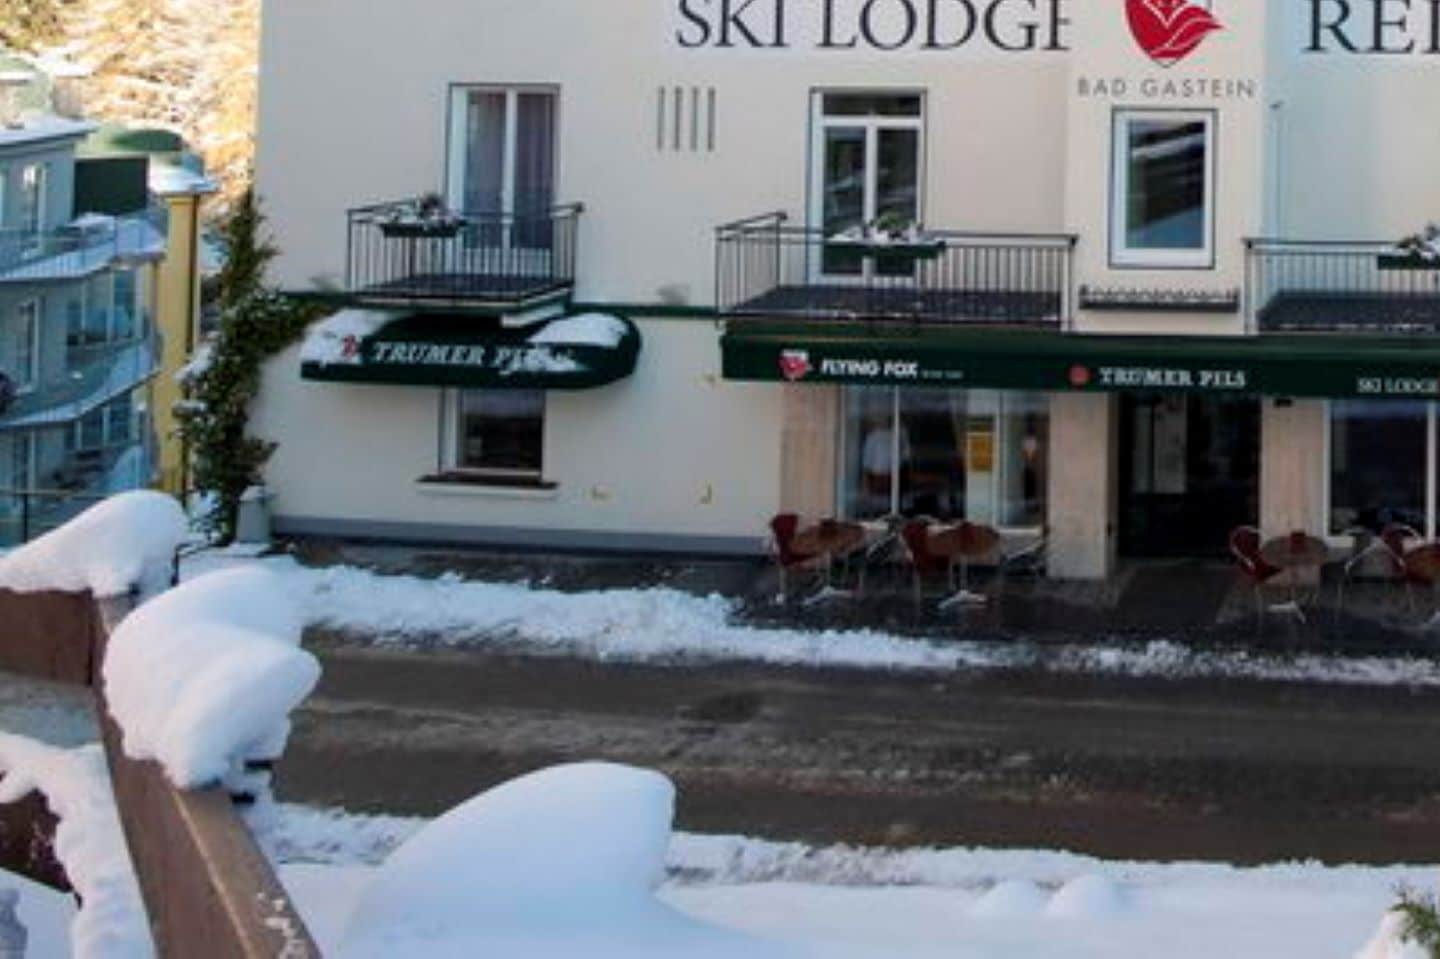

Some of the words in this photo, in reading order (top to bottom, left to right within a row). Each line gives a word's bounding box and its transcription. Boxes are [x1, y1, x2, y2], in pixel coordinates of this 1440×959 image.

[1077, 77, 1127, 98] BAD
[1140, 78, 1256, 98] GASTEIN
[373, 341, 485, 365] TRUMER
[821, 357, 880, 377] FLYING
[883, 360, 918, 378] FOX
[1098, 366, 1193, 387] TRUMER
[1198, 369, 1246, 388] PILS
[1356, 376, 1382, 393] SKI
[1384, 376, 1439, 393] LODGE
